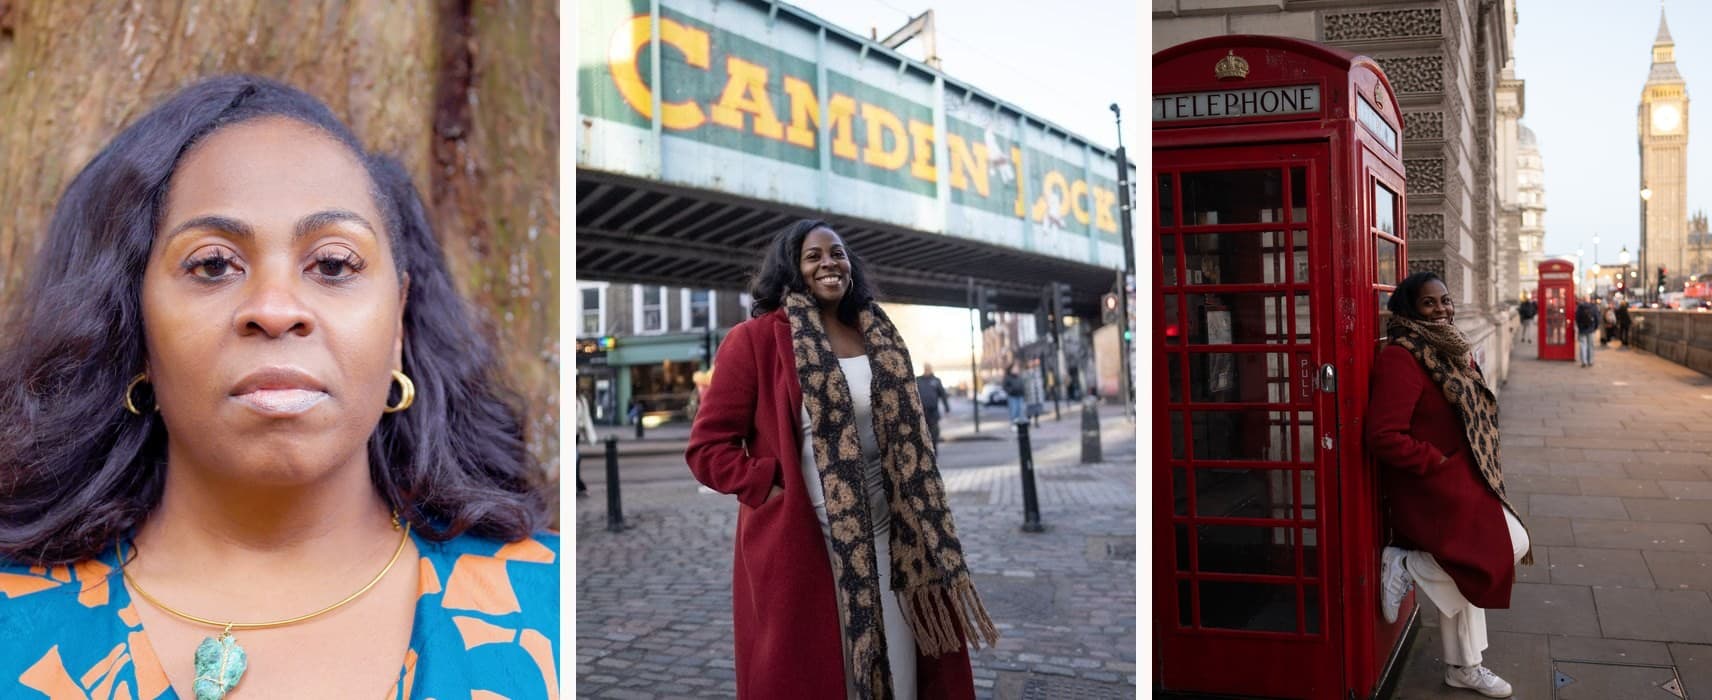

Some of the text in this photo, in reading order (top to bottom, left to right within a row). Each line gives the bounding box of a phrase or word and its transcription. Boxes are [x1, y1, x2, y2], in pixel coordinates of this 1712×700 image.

[1154, 87, 1313, 119] TELEPHONE
[608, 13, 1117, 234] CAMDEN LOCK
[1301, 359, 1309, 397] PULL
